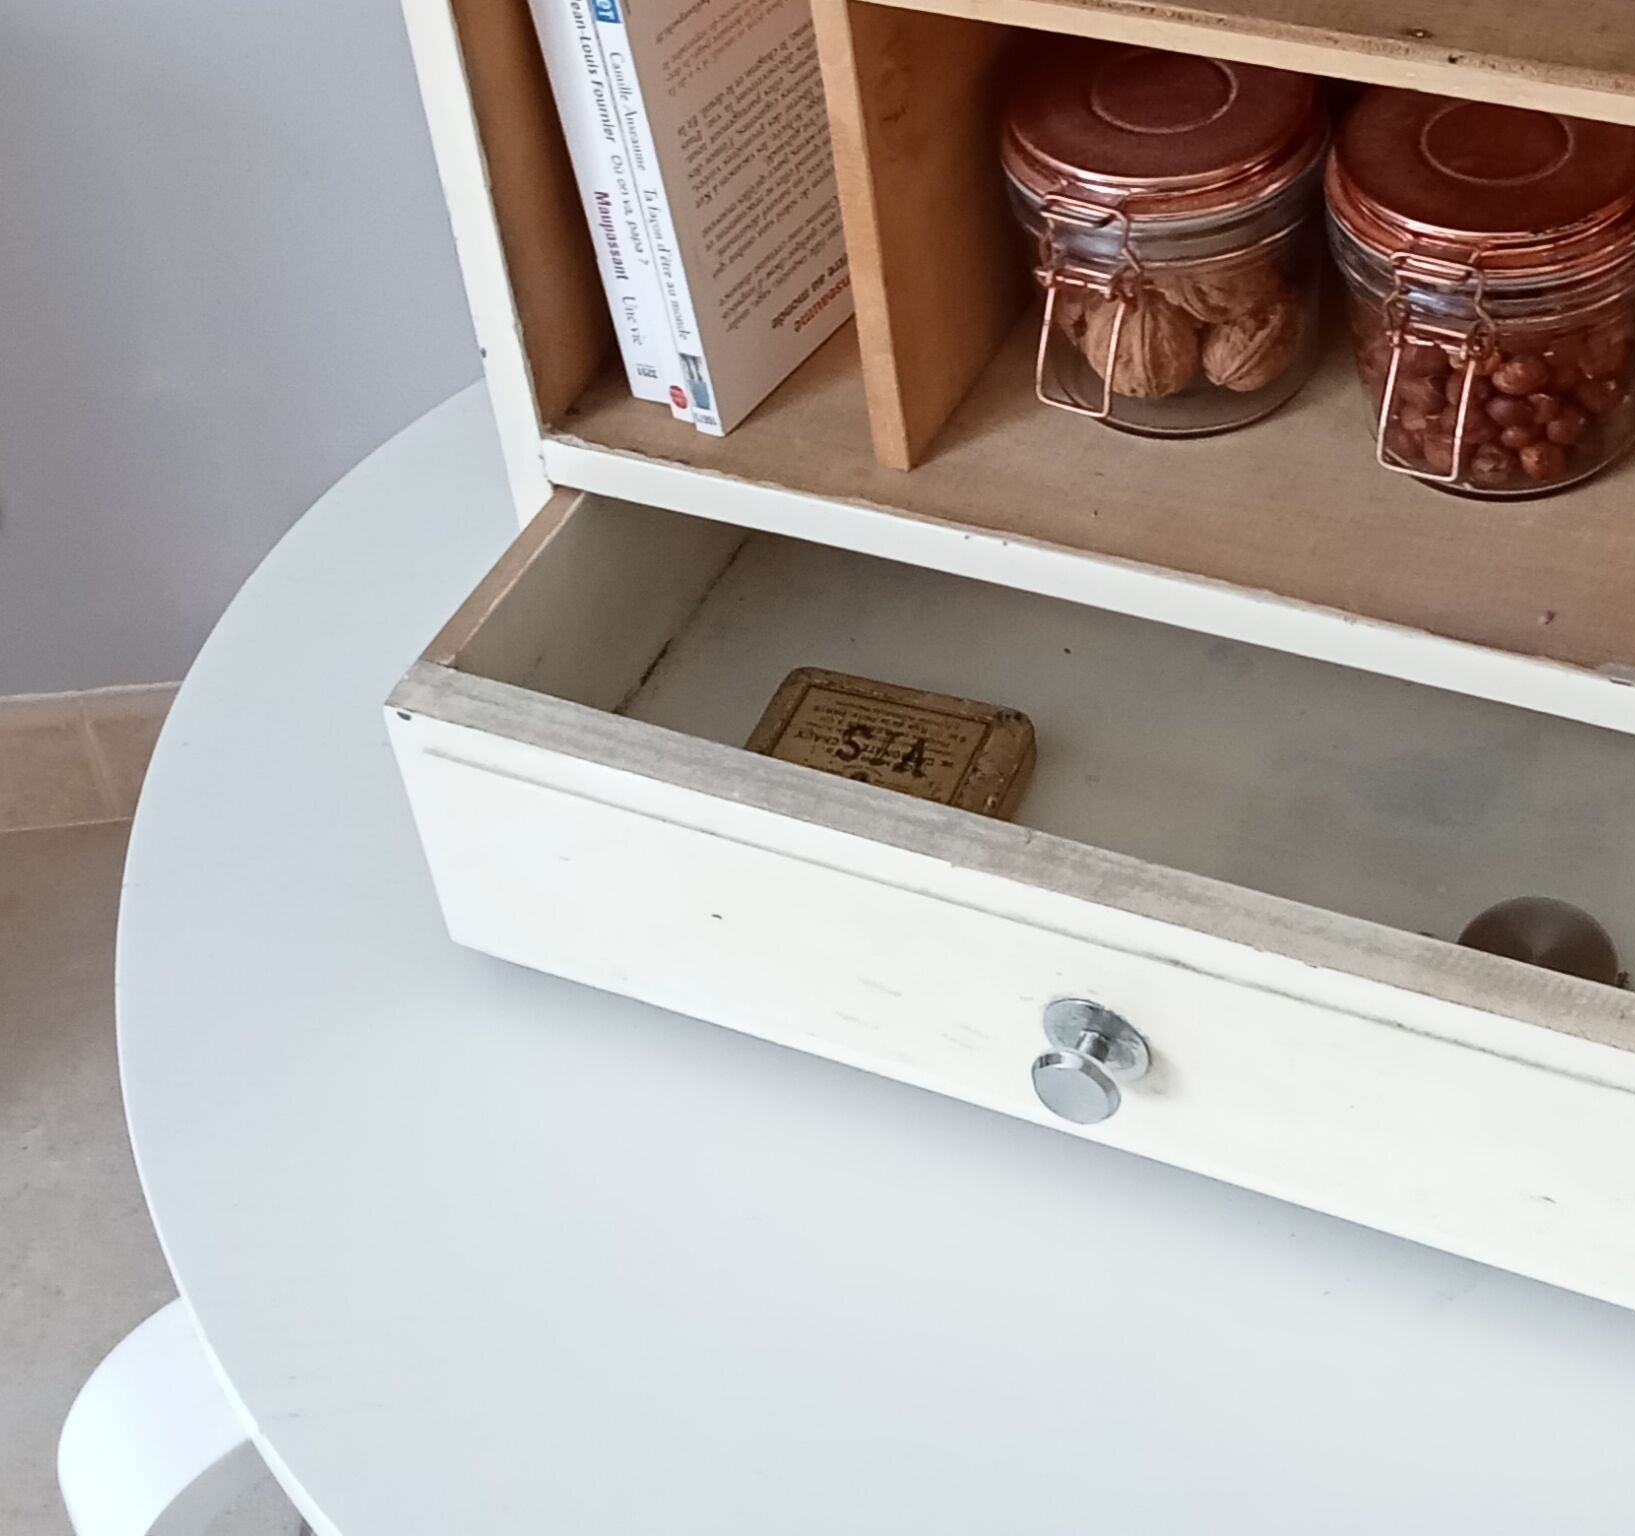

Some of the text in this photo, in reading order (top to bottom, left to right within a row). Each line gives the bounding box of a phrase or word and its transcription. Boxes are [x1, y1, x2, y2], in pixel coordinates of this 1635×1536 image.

[590, 80, 616, 143] Fournier
[625, 221, 644, 253] papa
[609, 52, 632, 101] Camille
[666, 282, 676, 296] au
[671, 301, 691, 340] monde
[593, 191, 629, 280] Maupassant
[622, 296, 637, 323] Une
